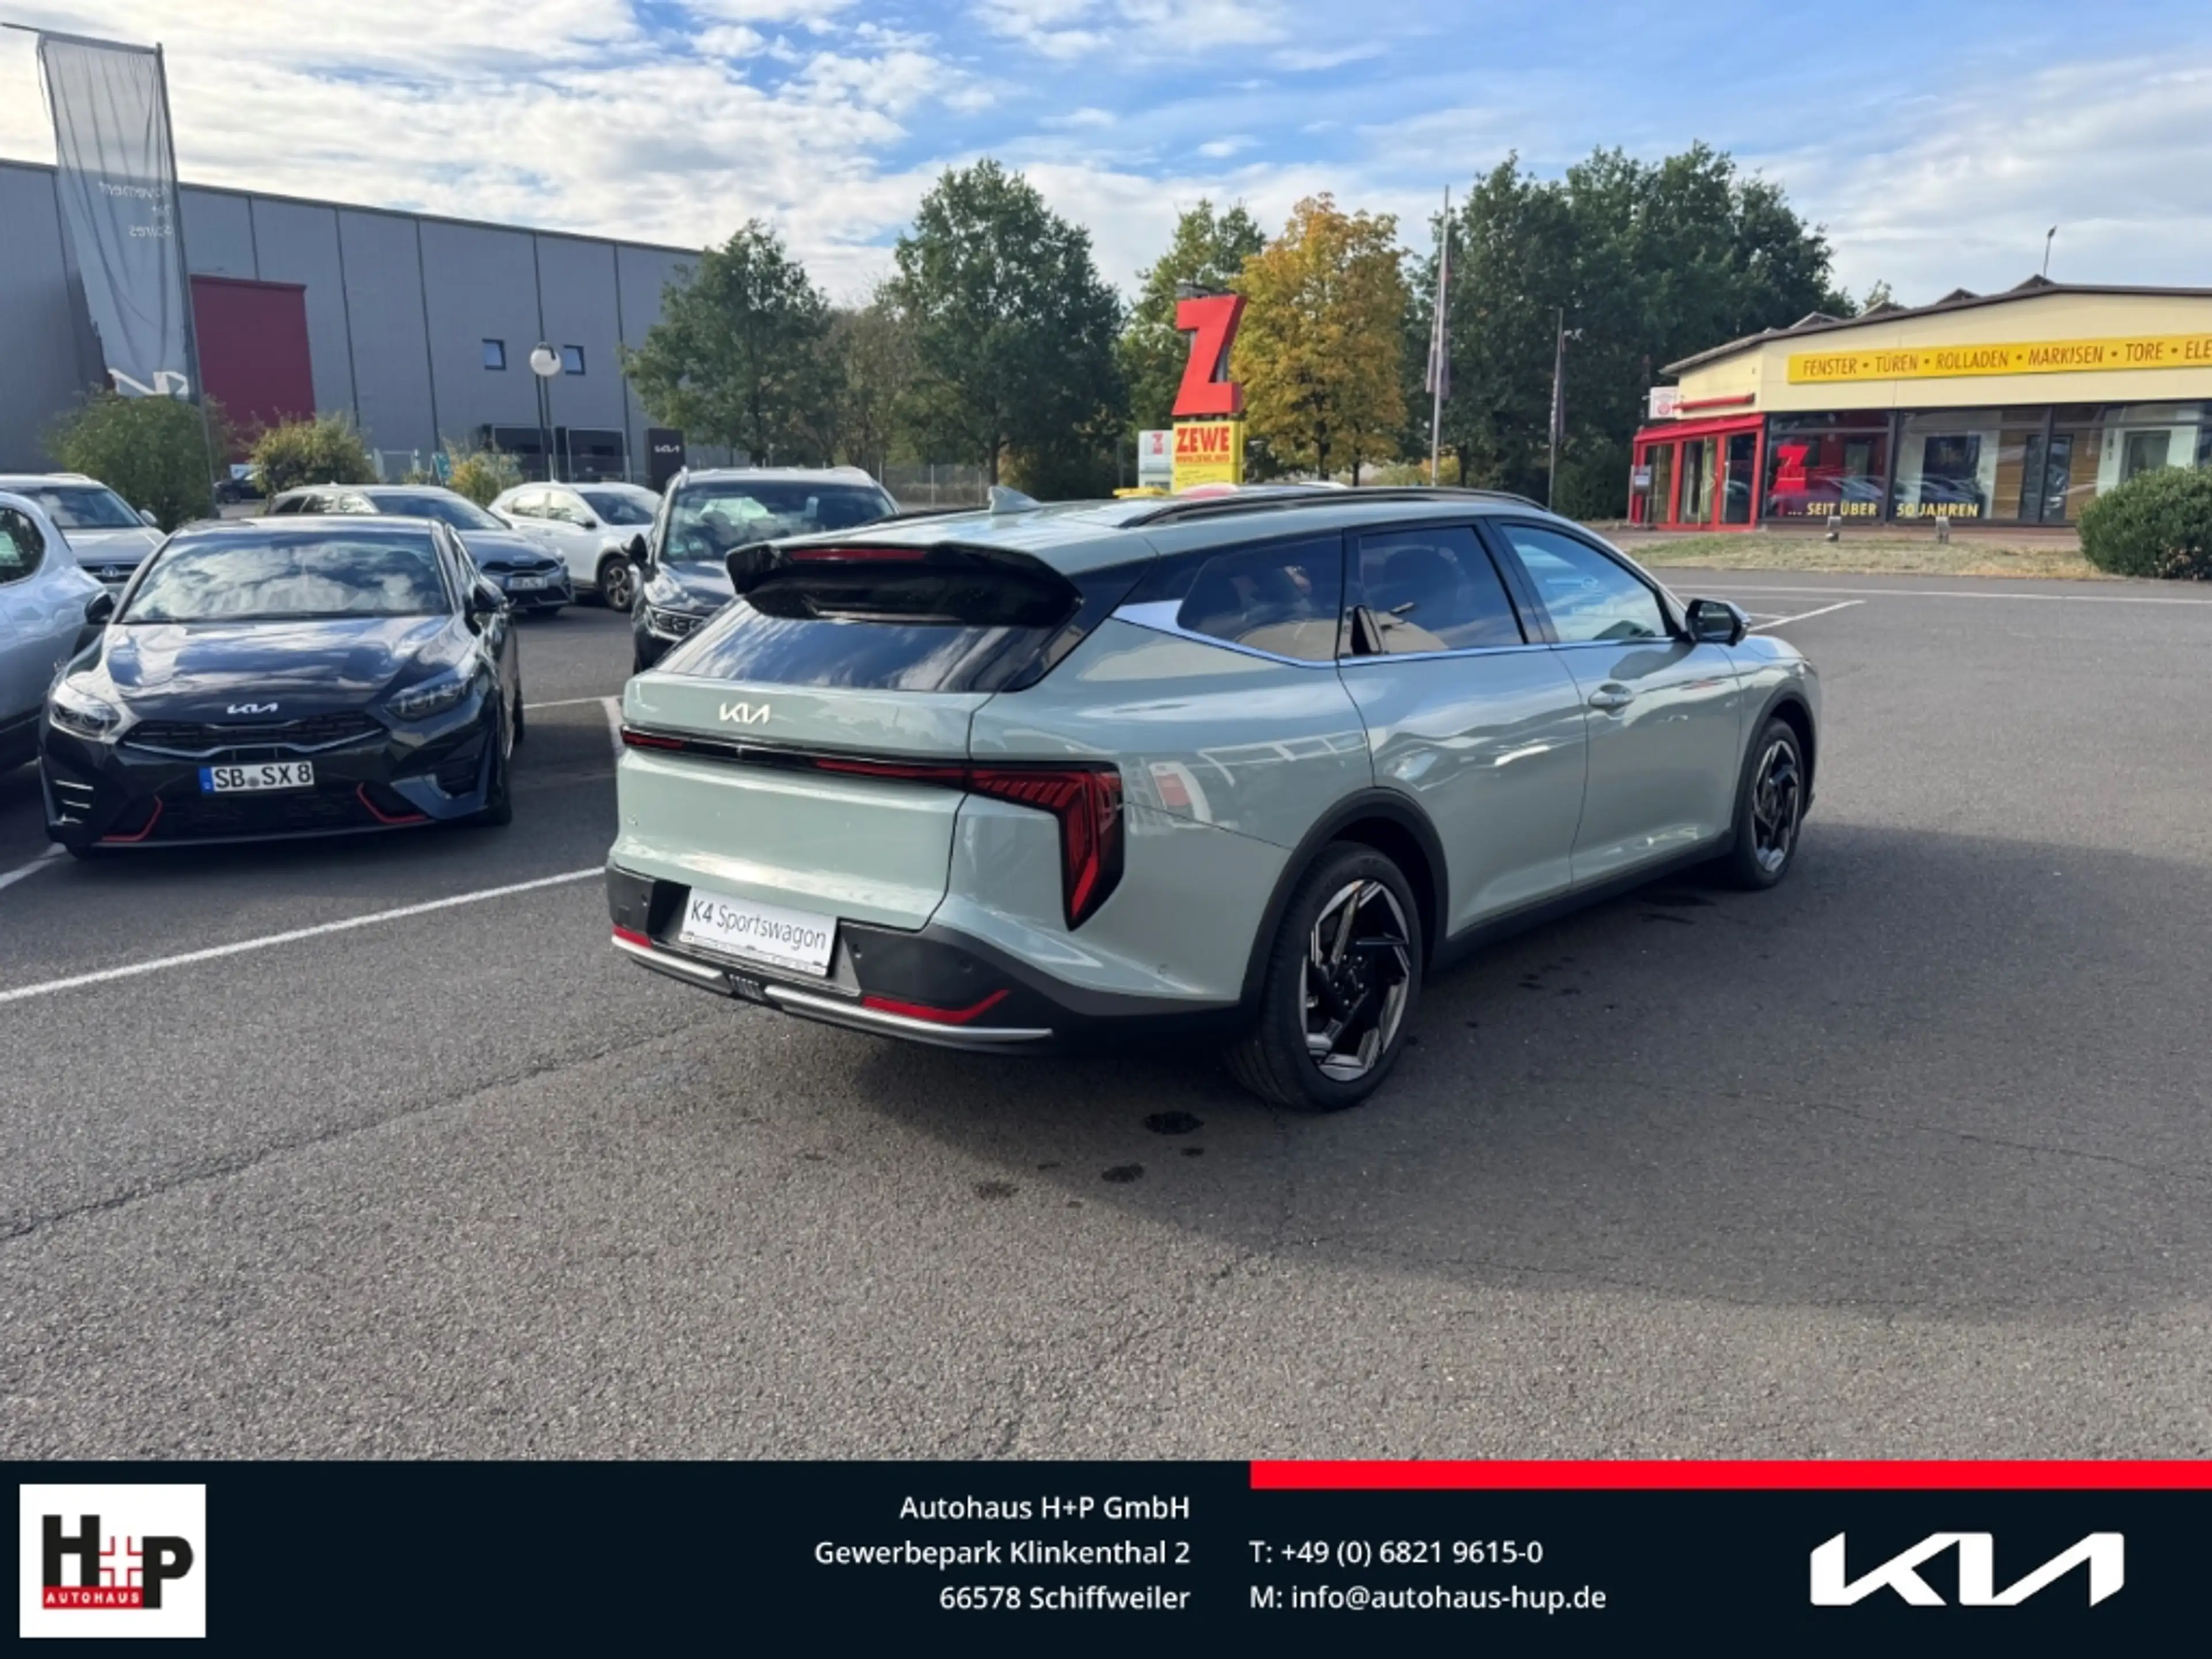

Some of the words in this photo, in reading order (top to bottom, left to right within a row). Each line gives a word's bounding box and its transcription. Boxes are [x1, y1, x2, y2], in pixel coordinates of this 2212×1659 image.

[1171, 294, 1243, 416] Z
[1803, 358, 1857, 376] FENSTER
[1875, 353, 1918, 372] TÜREN
[1936, 351, 2009, 369] ROLLADEN
[2028, 346, 2104, 366] MARKISEN
[2126, 342, 2164, 362] TORE
[1176, 426, 1230, 453] ZEWE
[1806, 502, 1836, 516] SEIT
[1840, 500, 1878, 516] ÜBER
[1896, 503, 1915, 517] 50
[1919, 503, 1979, 517] JAHREN
[227, 702, 278, 714] KIA
[719, 702, 770, 725] KIA
[214, 768, 245, 789] SB
[261, 766, 292, 786] SX
[297, 764, 312, 783] 8
[691, 899, 714, 923] K4
[717, 904, 827, 951] Sportswagon
